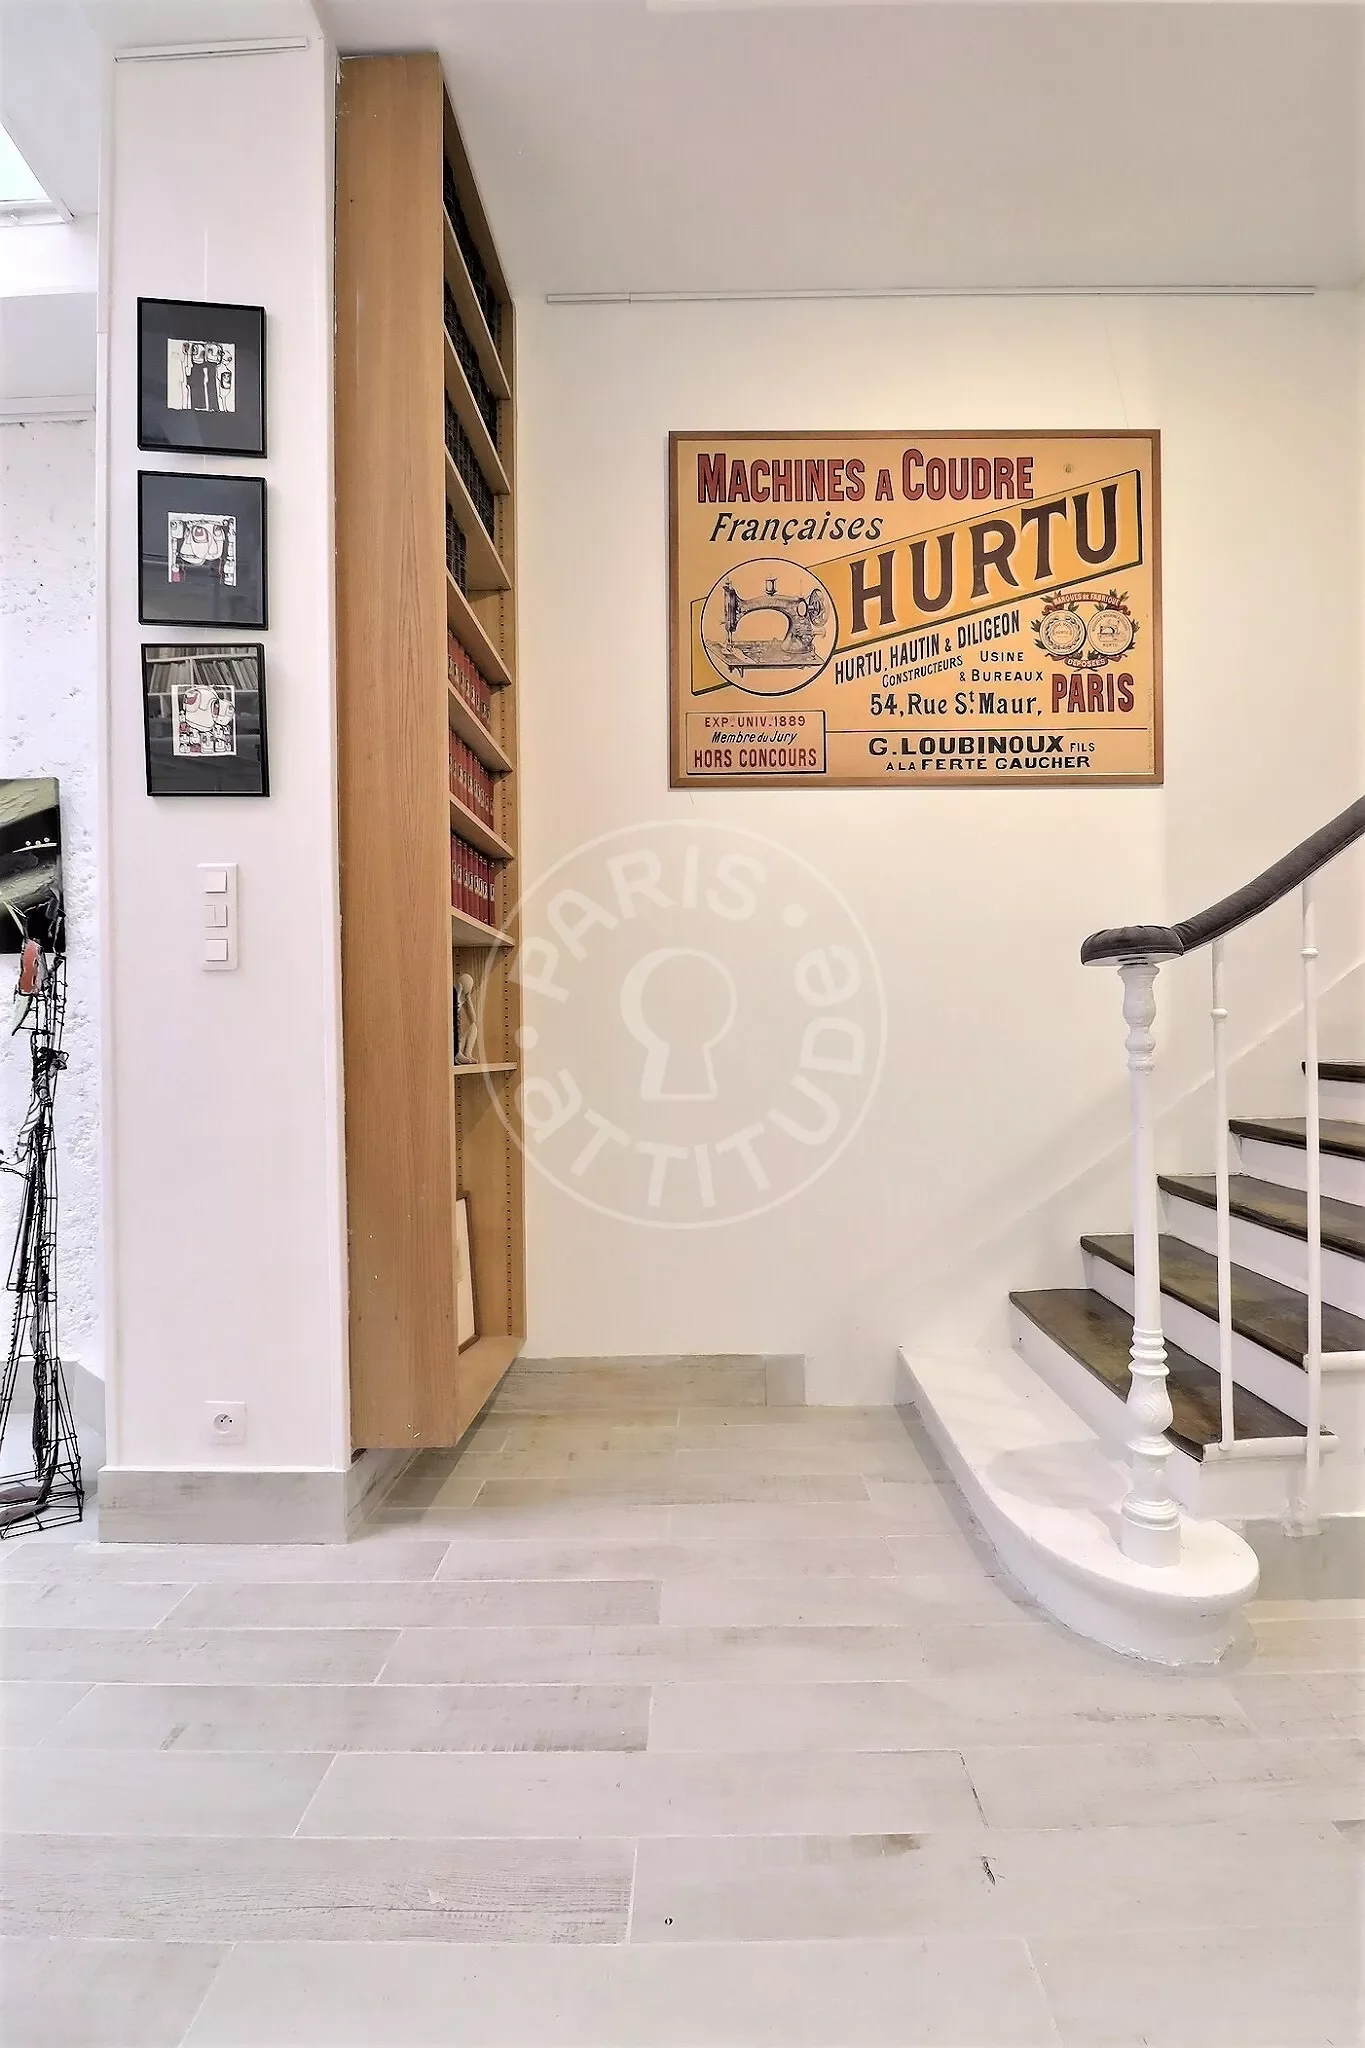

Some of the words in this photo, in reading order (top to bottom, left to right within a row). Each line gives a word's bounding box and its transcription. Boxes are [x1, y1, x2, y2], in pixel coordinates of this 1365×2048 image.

[697, 453, 866, 503] MACHINES
[875, 472, 894, 501] A
[901, 448, 1034, 501] COUDRE
[709, 510, 883, 546] Françaises
[849, 483, 1119, 634] HURTU
[890, 632, 940, 669] HAUTIN
[944, 638, 952, 652] &
[957, 609, 1020, 649] DILIGEON
[980, 650, 1024, 662] USINE
[882, 655, 963, 688] CONSTRUCTEURS
[959, 671, 966, 682] &
[971, 669, 1044, 682] BUREAUX
[870, 693, 904, 717] 54,
[907, 692, 948, 715] Rue
[979, 692, 1042, 717] Maur,
[1051, 672, 1134, 713] PARIS
[712, 731, 756, 744] Membre
[757, 733, 768, 743] du
[769, 731, 798, 745] Jury
[1069, 742, 1095, 753] FILS
[694, 749, 732, 768] HORS
[739, 748, 817, 768] CONCOURS
[995, 756, 1091, 770] GAUCHER
